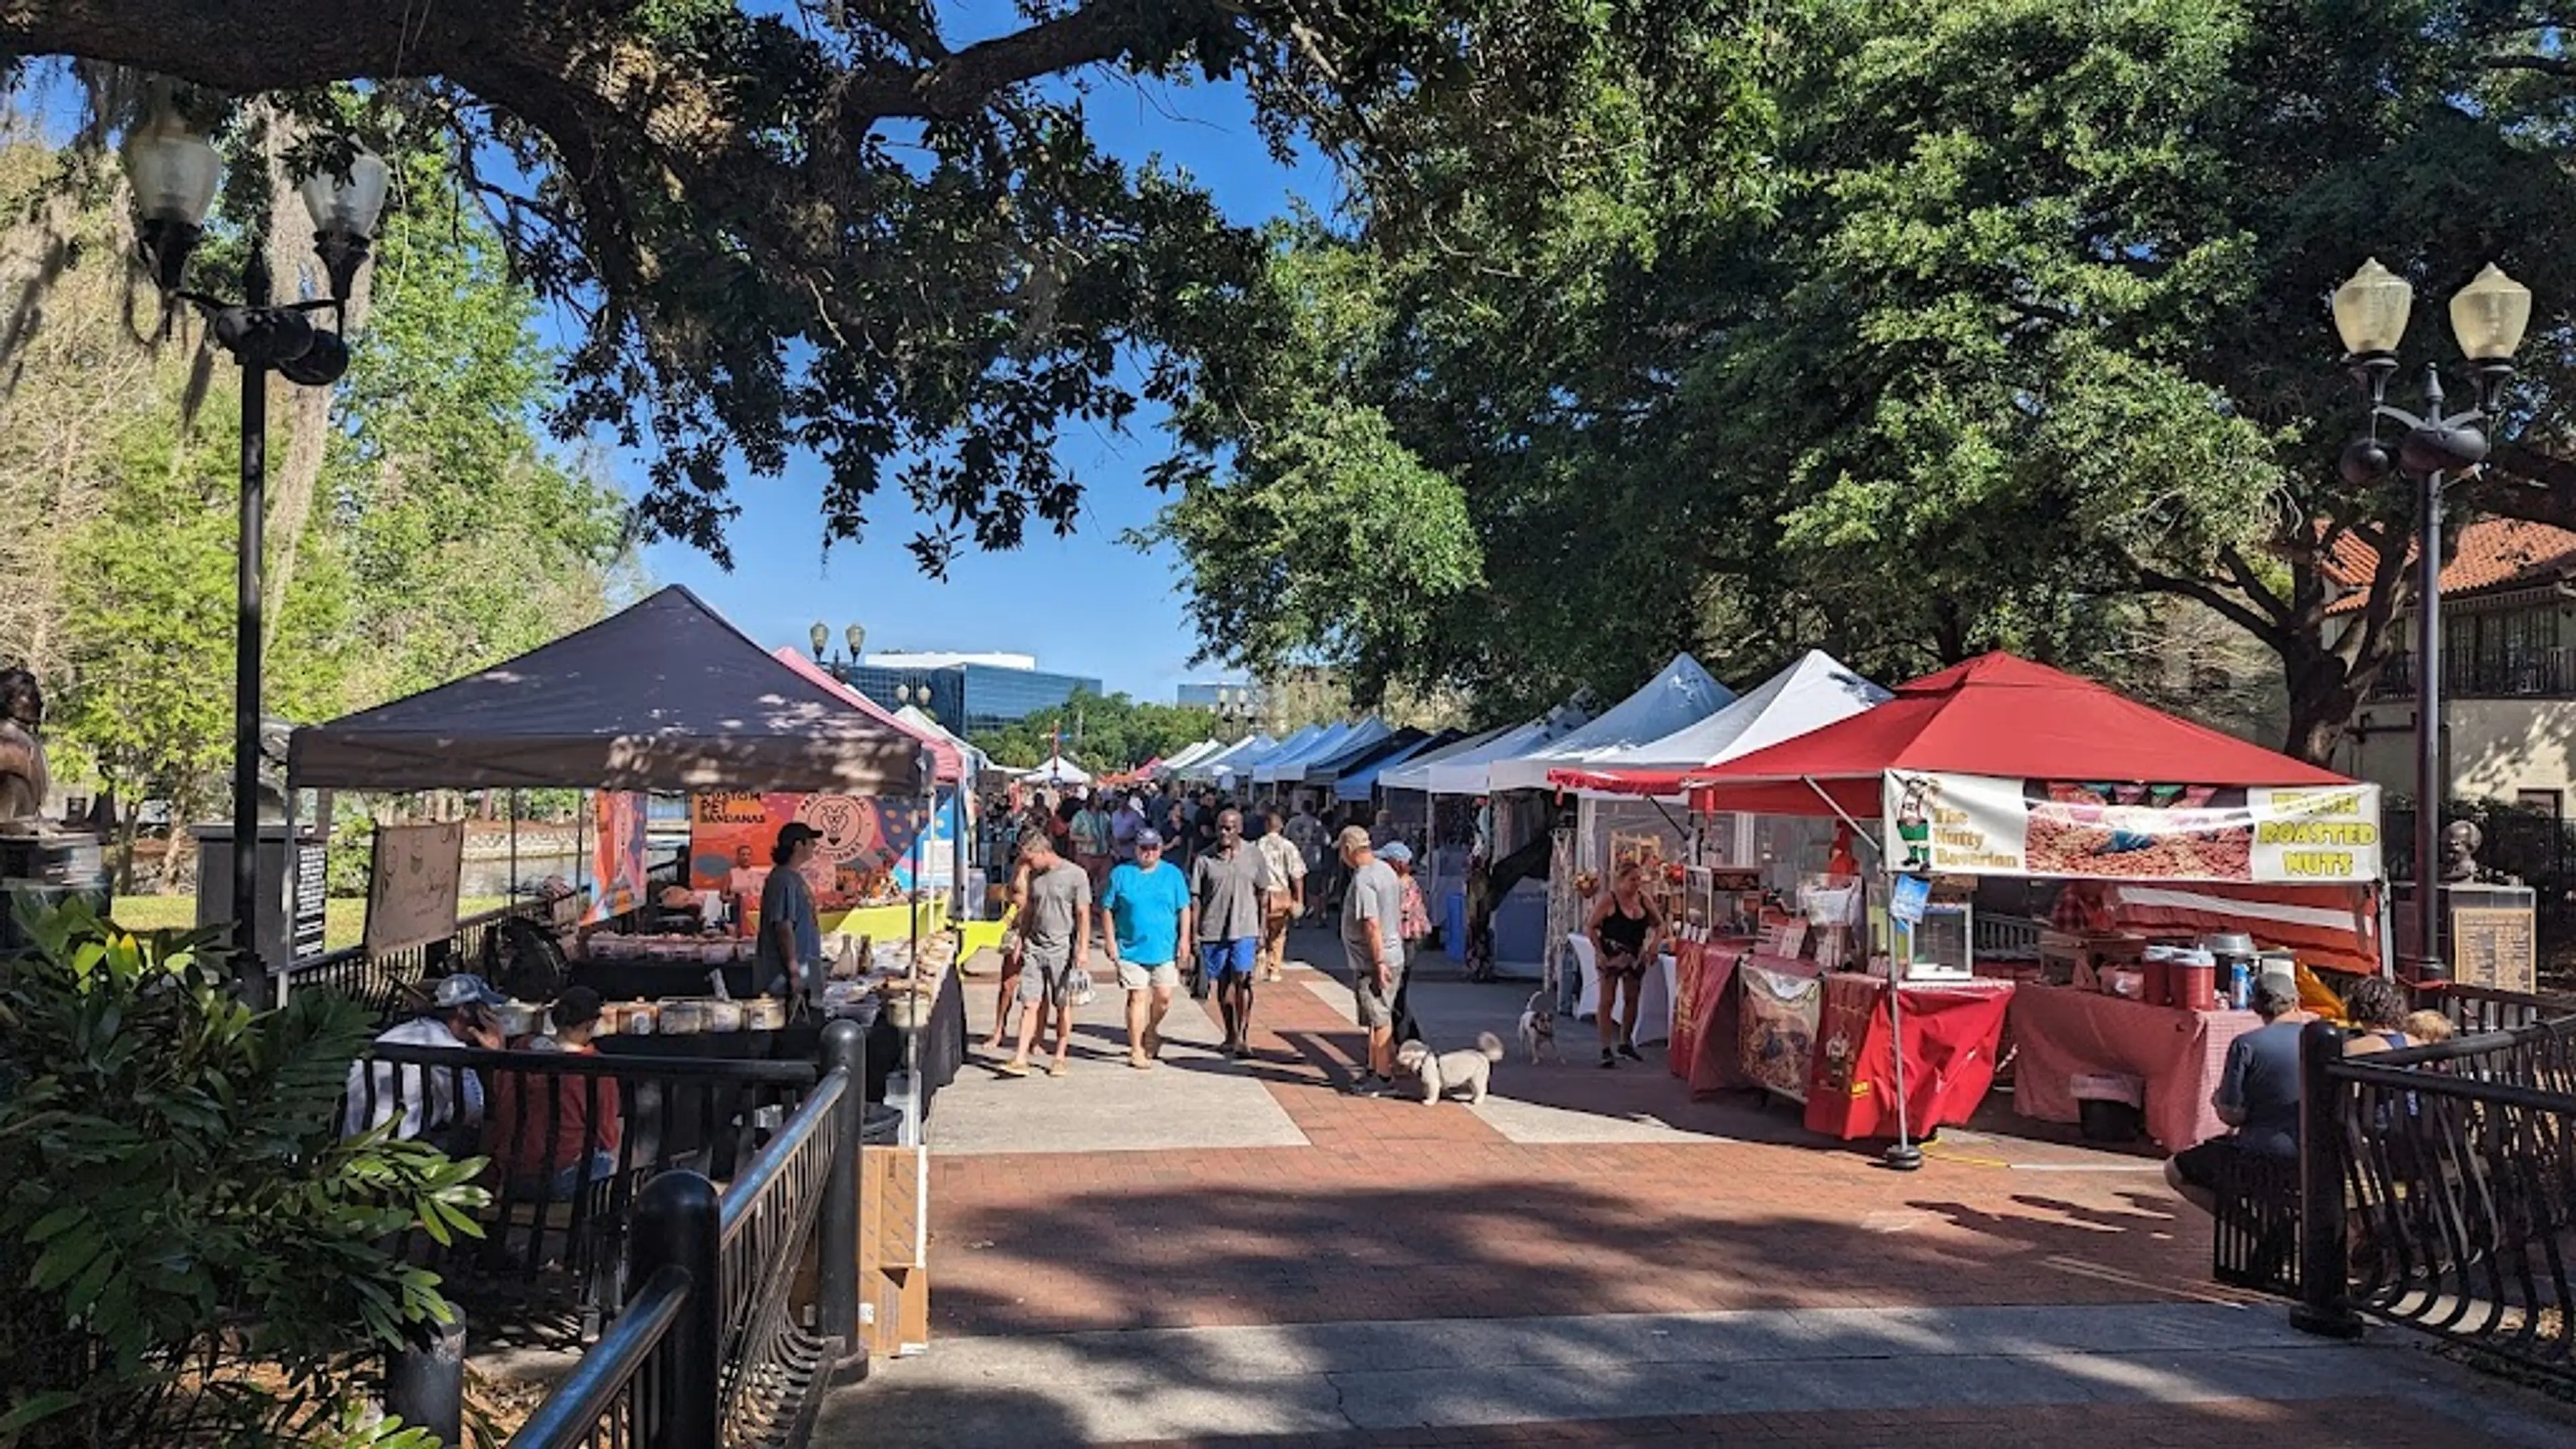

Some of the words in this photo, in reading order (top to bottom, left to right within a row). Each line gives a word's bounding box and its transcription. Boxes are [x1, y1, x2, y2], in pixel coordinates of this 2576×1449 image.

[699, 791, 761, 802] USTOM
[1934, 807, 1969, 824] The
[1933, 828, 1984, 851] Nutty
[2257, 820, 2378, 845] ROASTED
[2283, 851, 2353, 876] NUTS
